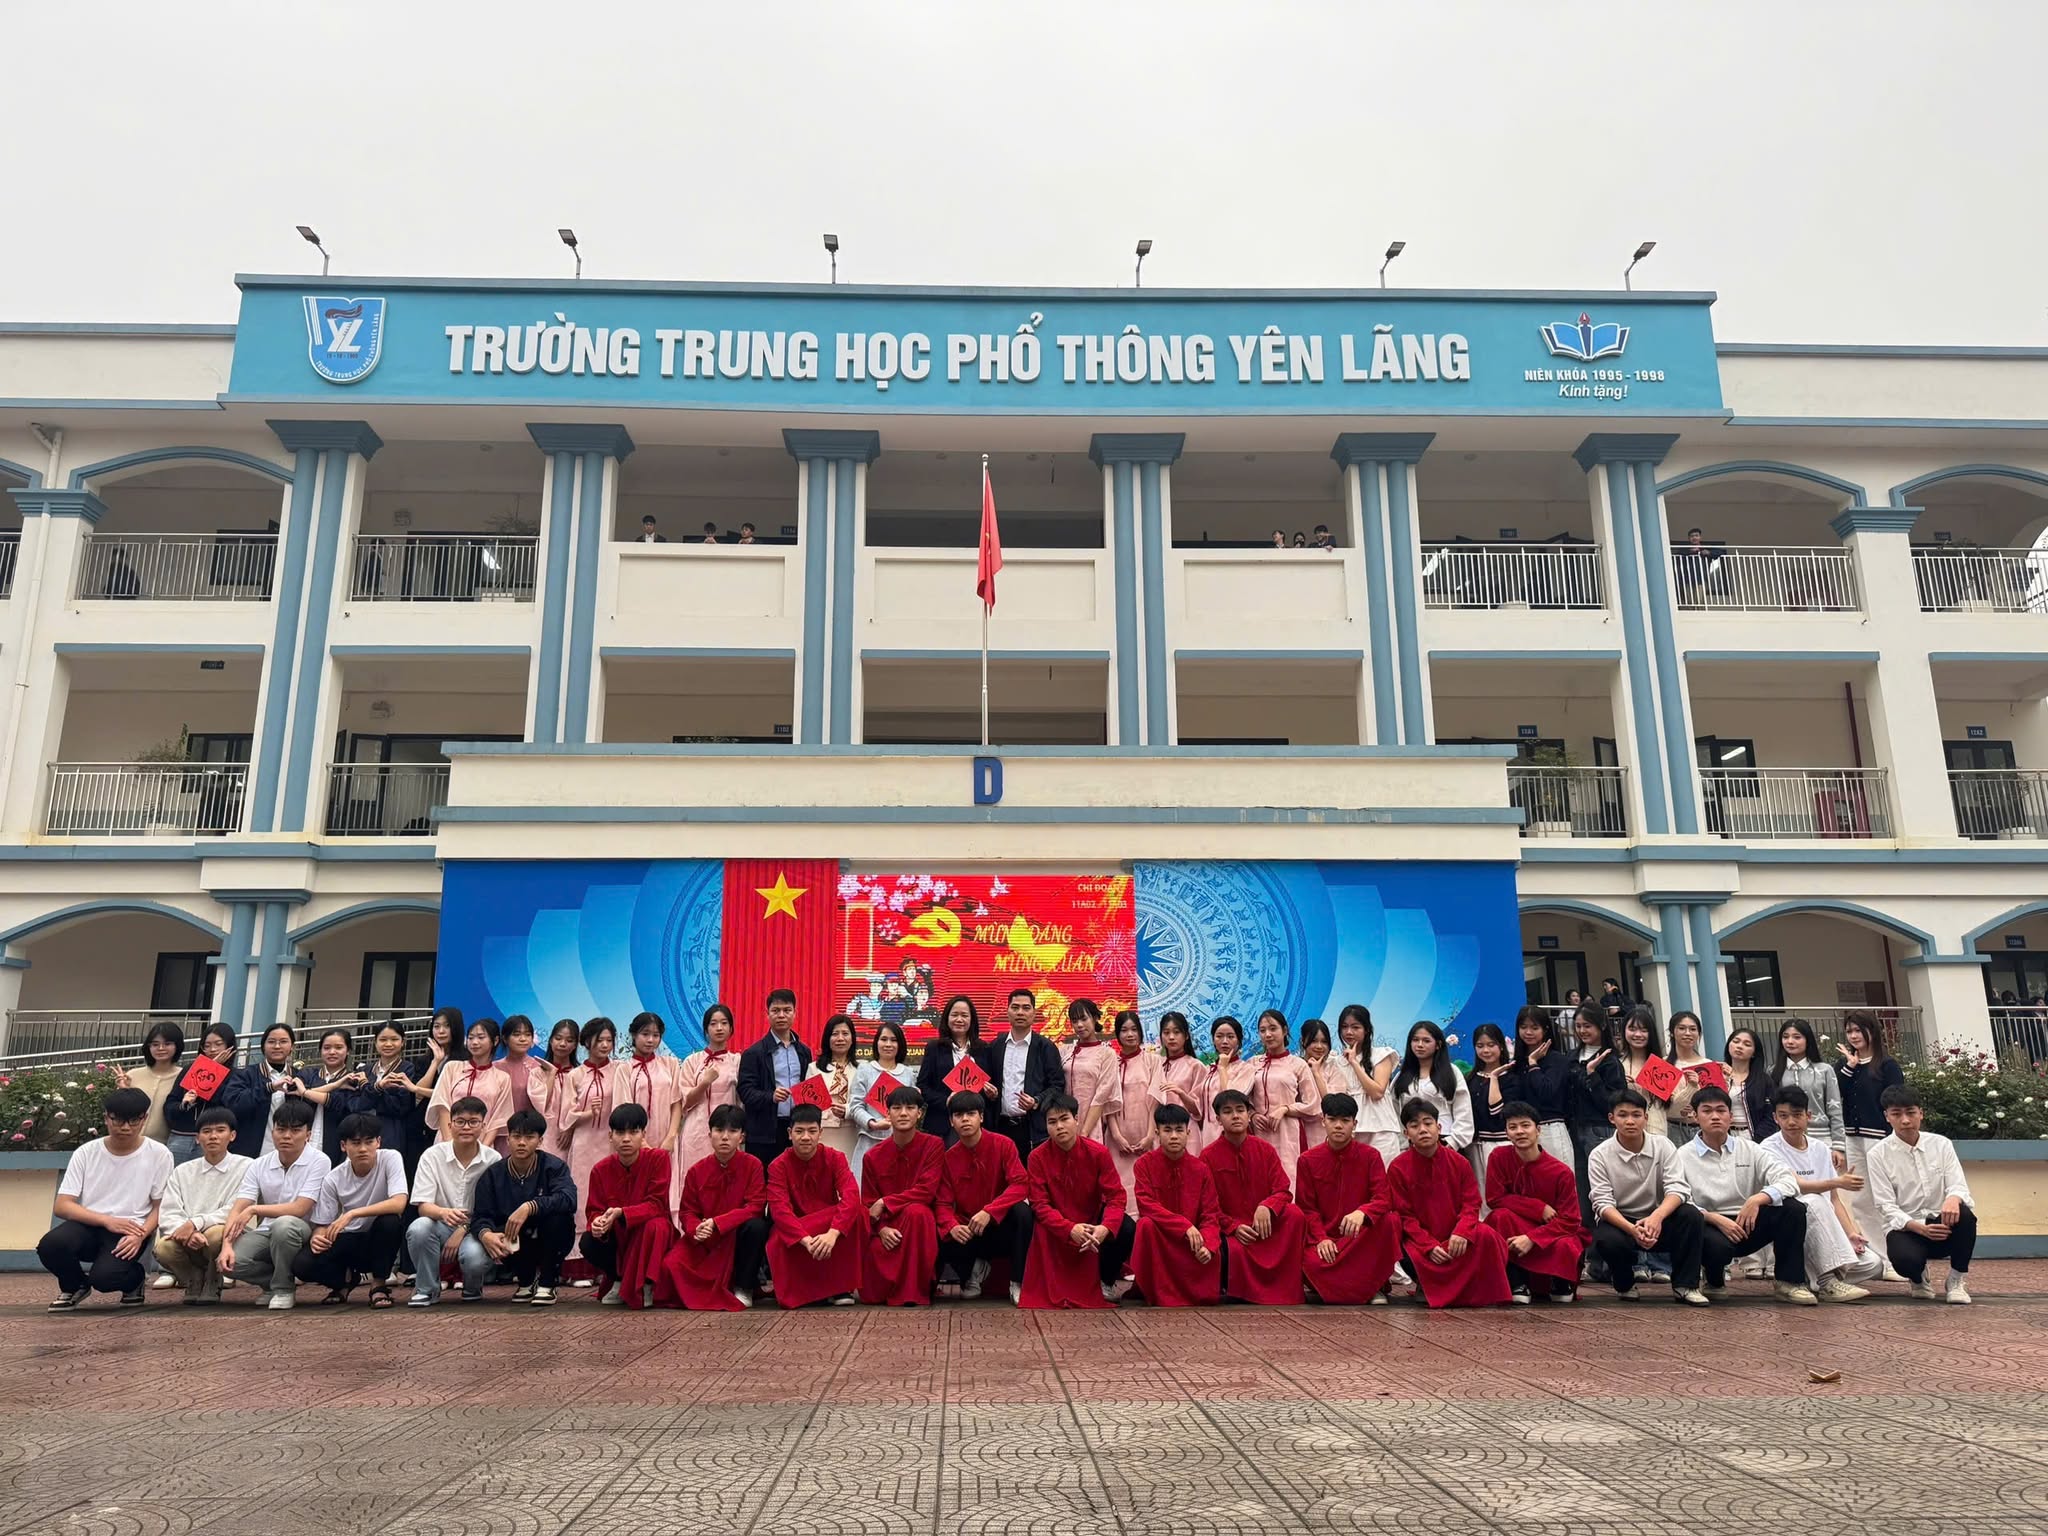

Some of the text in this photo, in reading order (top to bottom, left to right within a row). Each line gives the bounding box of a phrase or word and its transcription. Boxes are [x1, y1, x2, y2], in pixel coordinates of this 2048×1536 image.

[446, 311, 1471, 389] TRƯỜNG TRUNG HỌC PHỔ THÔNG YÊN LÃNG
[1524, 368, 1553, 381] NIÊN
[1556, 366, 1588, 381] KHÓA
[1592, 370, 1623, 381] 1995
[1634, 370, 1665, 381] 1998
[1559, 384, 1628, 400] Kính tặng!
[974, 757, 1003, 804] D
